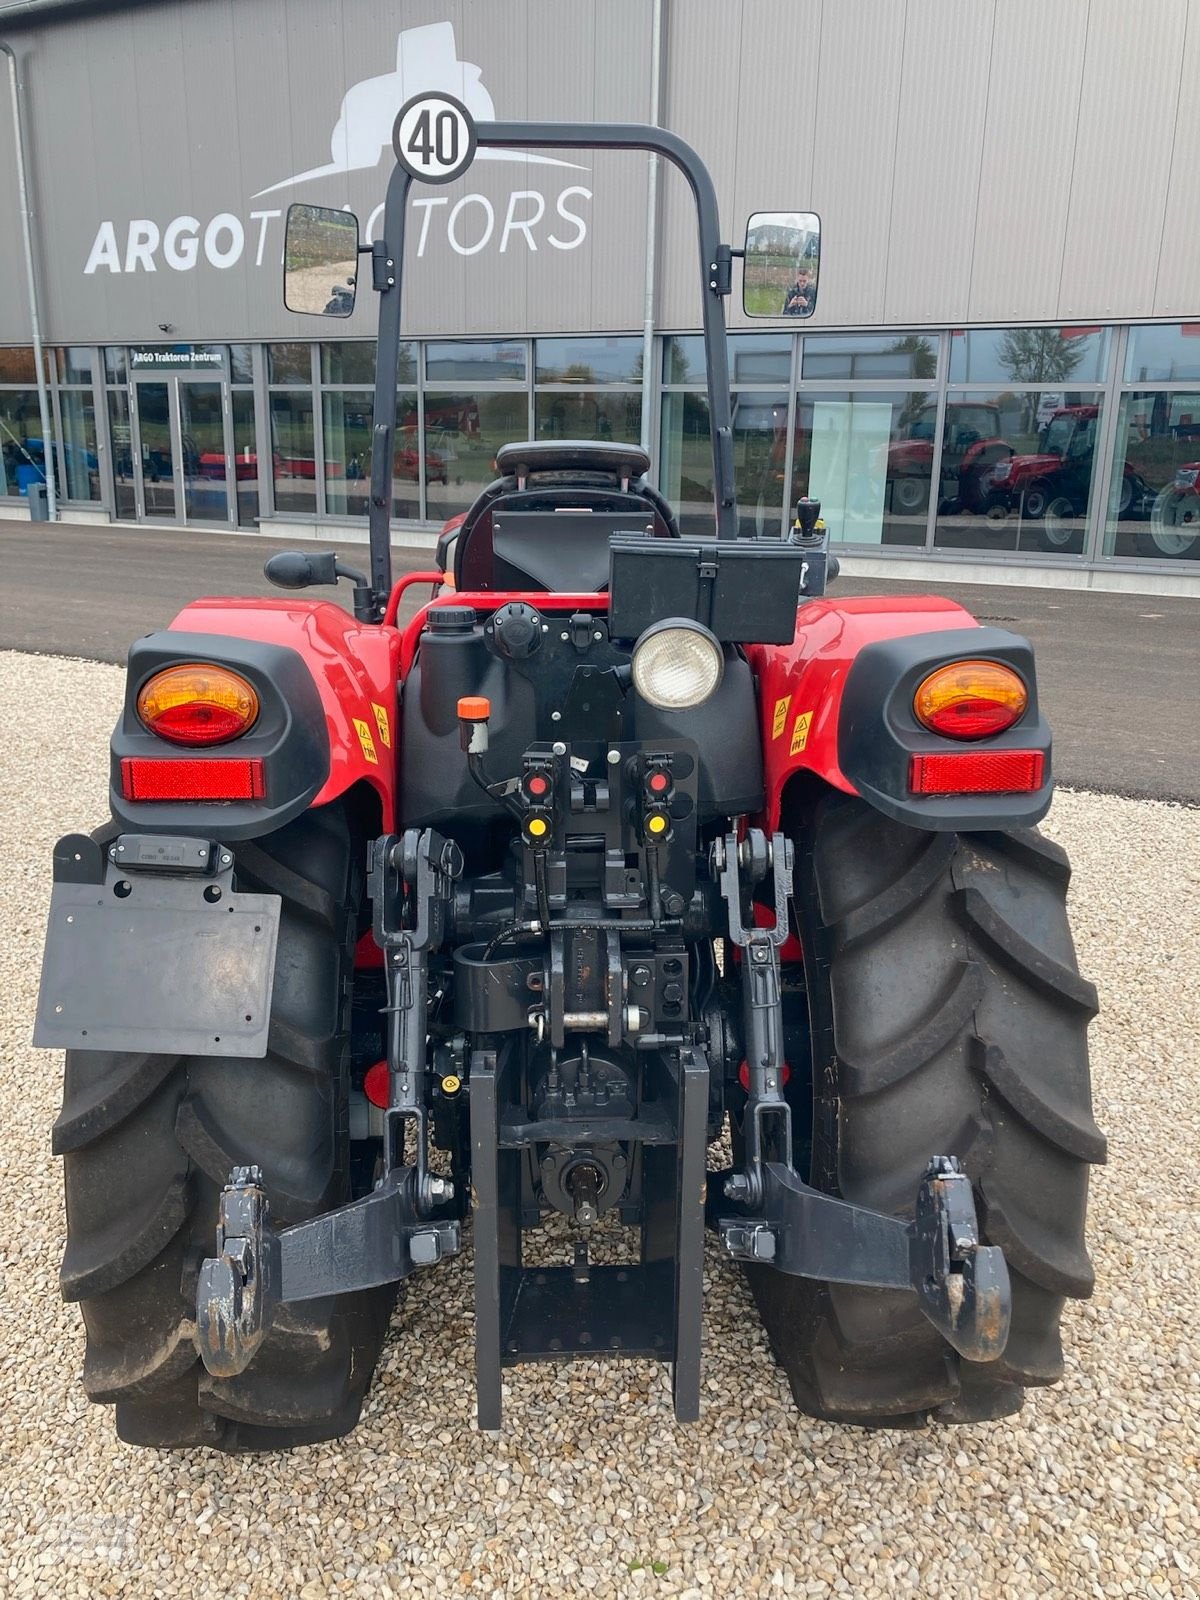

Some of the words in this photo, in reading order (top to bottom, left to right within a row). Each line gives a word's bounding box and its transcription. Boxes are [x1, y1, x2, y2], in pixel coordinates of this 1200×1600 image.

[407, 109, 459, 166] 40
[133, 352, 154, 363] ARGO
[154, 351, 190, 363] Traktoren
[190, 351, 222, 362] Zentrum
